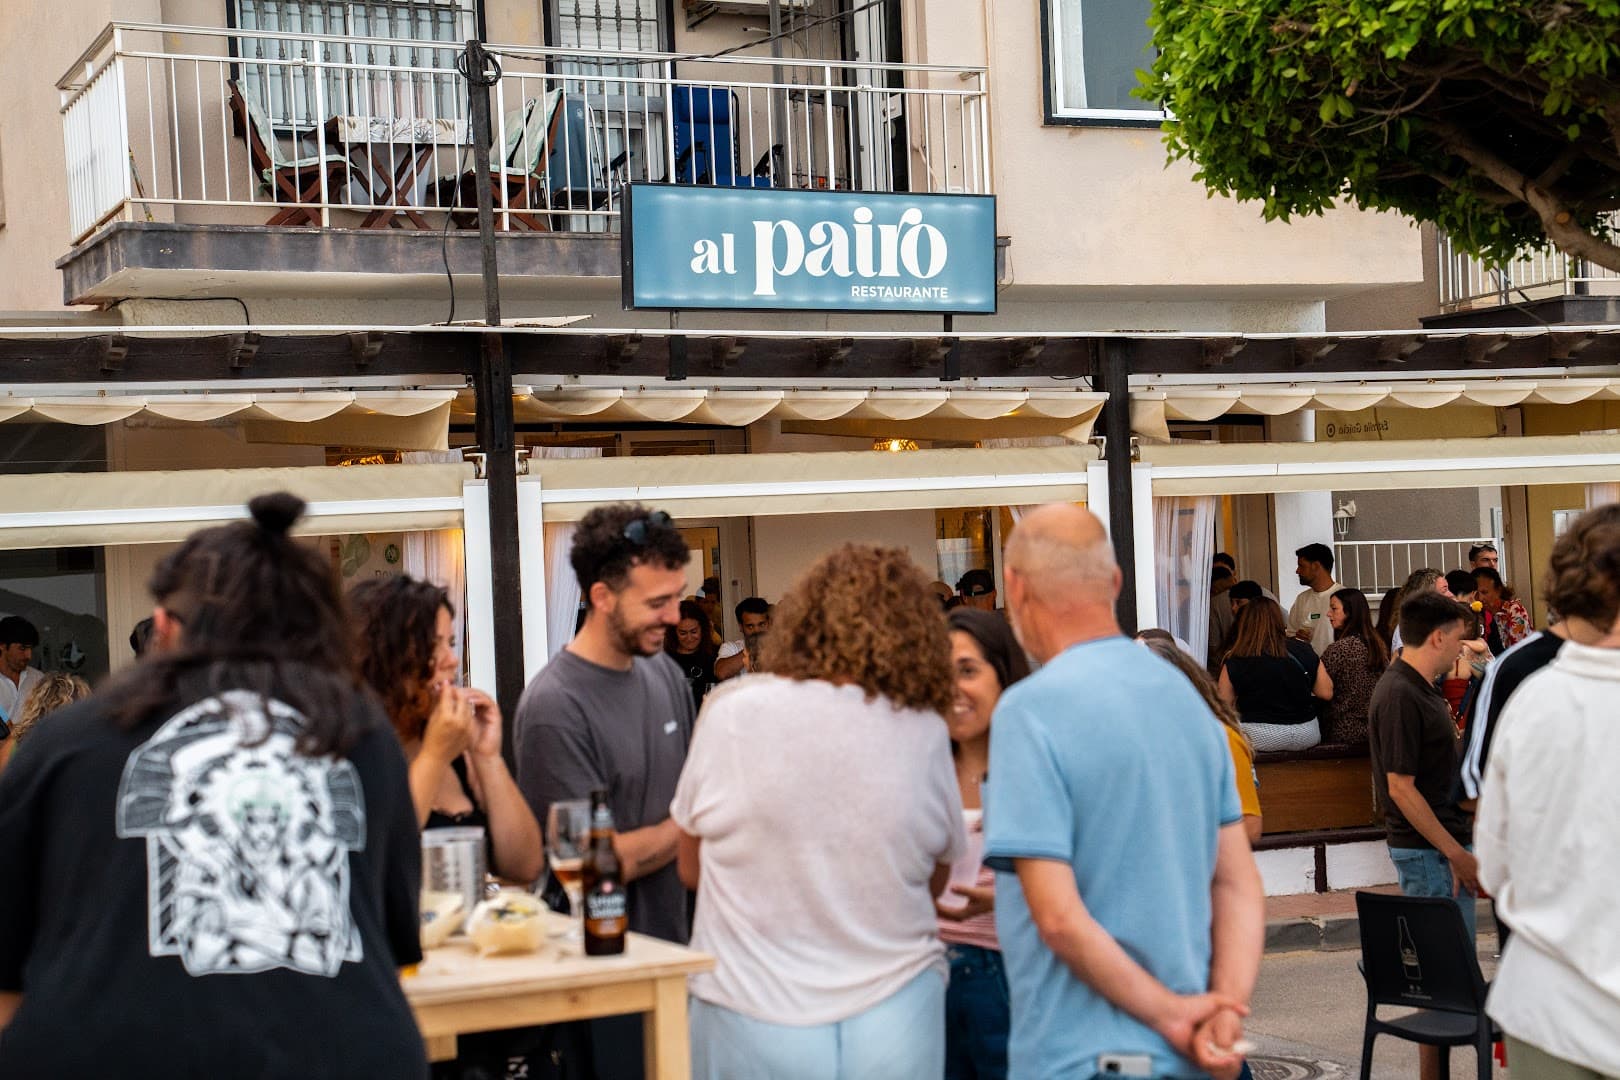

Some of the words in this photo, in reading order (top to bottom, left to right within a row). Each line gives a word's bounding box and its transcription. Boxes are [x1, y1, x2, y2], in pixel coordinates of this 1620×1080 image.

[690, 233, 737, 275] al
[753, 206, 948, 296] pairo
[851, 285, 949, 299] RESTAURANTE
